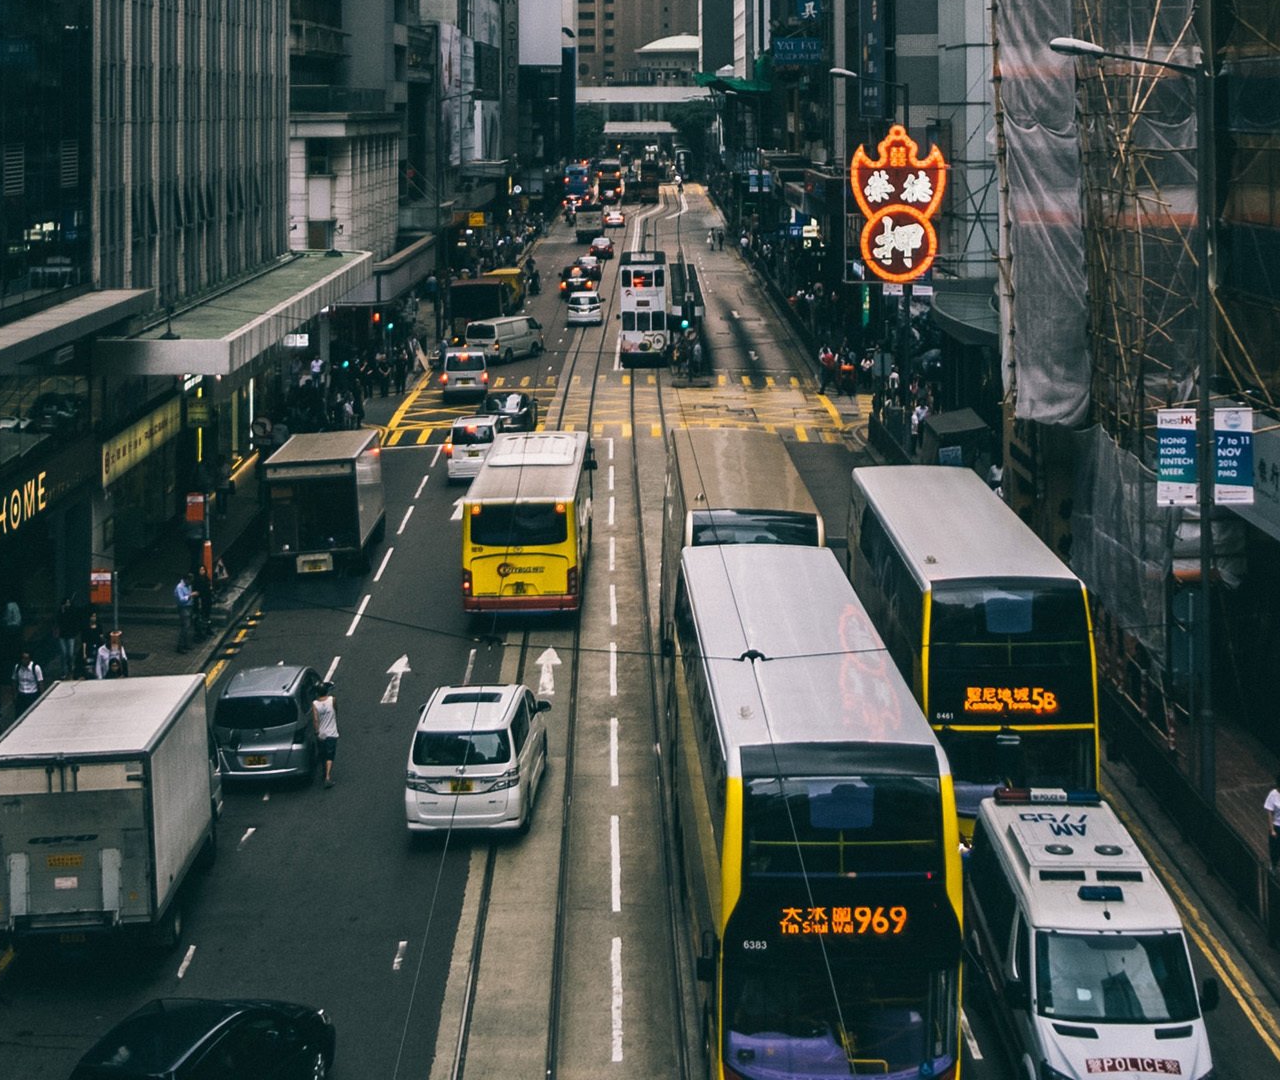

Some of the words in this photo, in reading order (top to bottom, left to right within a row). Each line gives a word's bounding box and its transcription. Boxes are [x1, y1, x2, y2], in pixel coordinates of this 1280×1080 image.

[872, 216, 924, 269] 押
[1160, 437, 1187, 445] HONG
[1217, 437, 1225, 446] 7
[1227, 437, 1238, 446] to
[1160, 447, 1186, 455] KONG
[1217, 448, 1242, 457] NOV
[1160, 457, 1194, 466] FINTECH
[1218, 459, 1238, 468] 2016
[1160, 468, 1185, 476] WEEK
[1217, 469, 1238, 478] PMQ
[1032, 687, 1057, 713] 5B
[1049, 823, 1087, 837] AM
[853, 906, 908, 934] 969
[780, 921, 800, 934] Tin
[831, 921, 854, 934] Wai
[743, 940, 767, 950] 6383
[1102, 1058, 1166, 1073] POLICE
